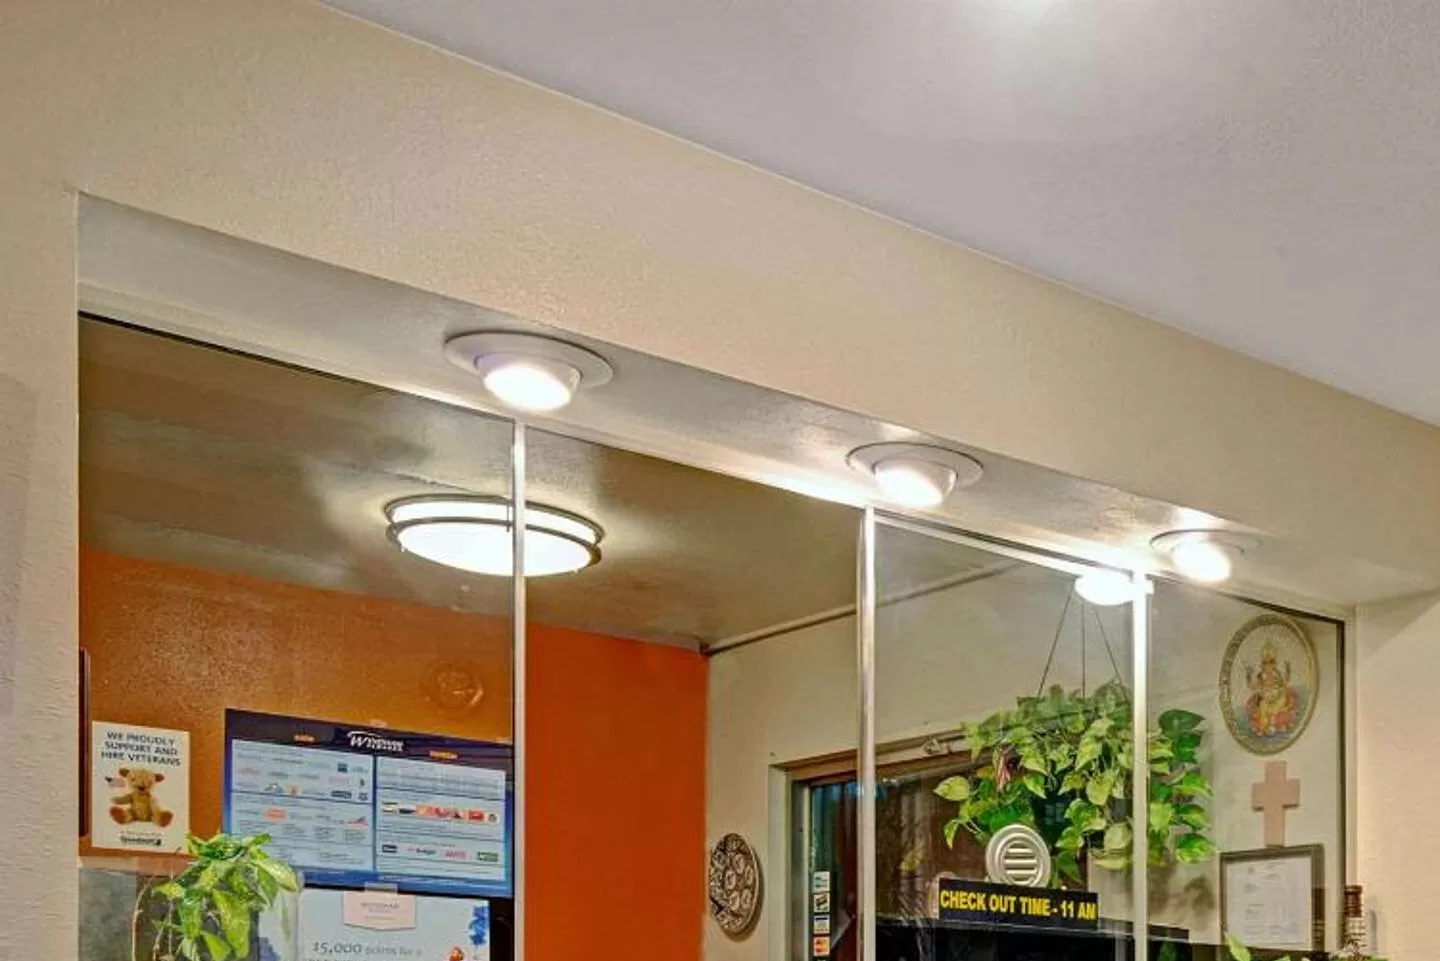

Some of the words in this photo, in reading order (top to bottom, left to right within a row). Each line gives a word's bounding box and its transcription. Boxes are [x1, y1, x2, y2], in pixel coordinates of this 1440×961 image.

[940, 890, 986, 911] CHECK
[989, 894, 1017, 914] OUT
[1060, 900, 1074, 918] 11
